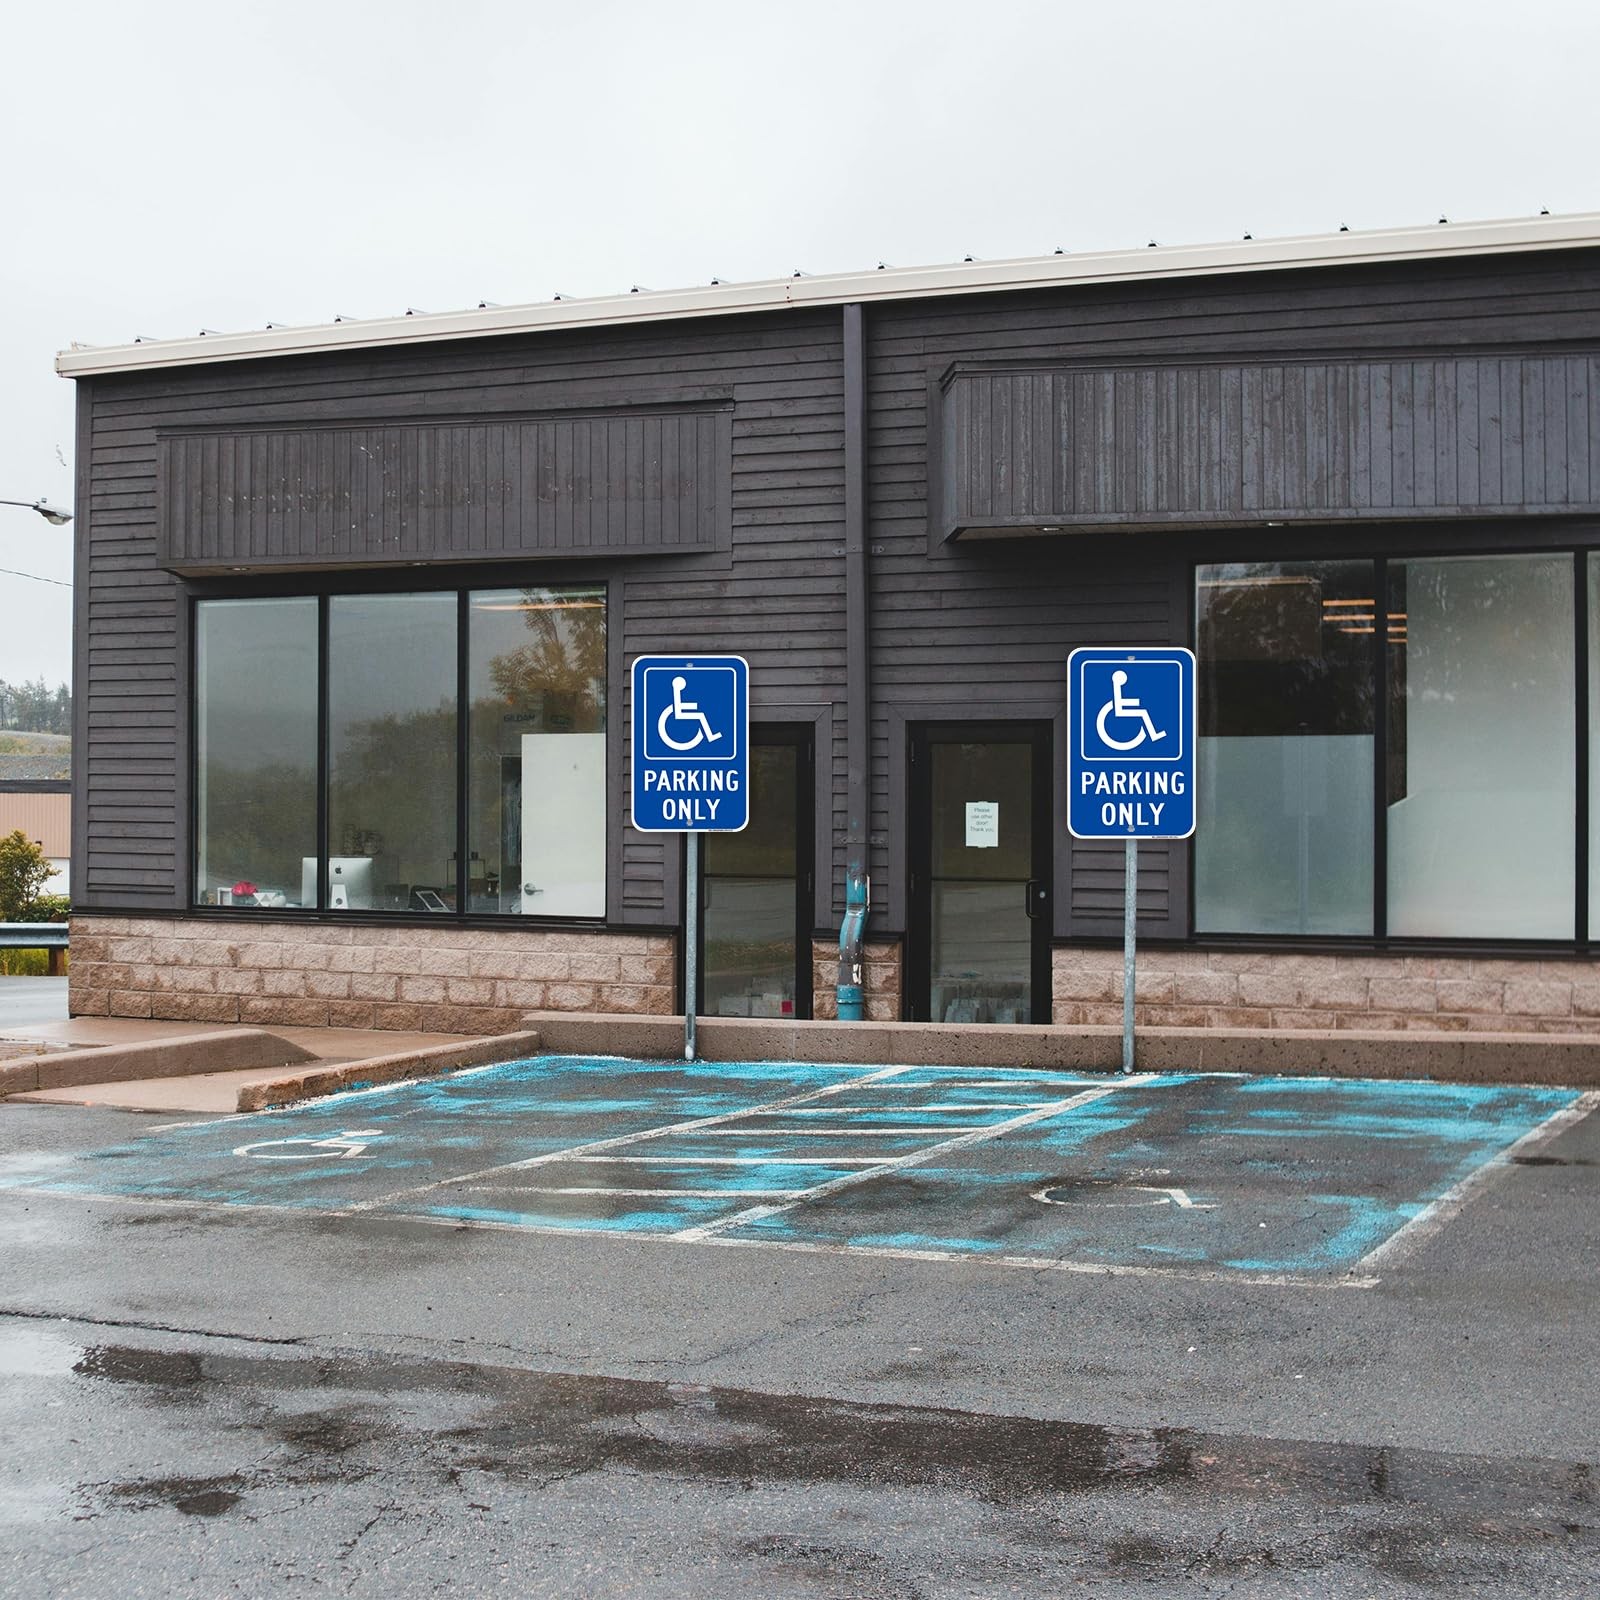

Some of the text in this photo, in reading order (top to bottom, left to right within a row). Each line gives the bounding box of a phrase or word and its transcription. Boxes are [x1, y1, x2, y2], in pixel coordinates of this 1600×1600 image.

[644, 770, 739, 792] PARKING
[1081, 772, 1185, 795] PARKING
[662, 799, 721, 820] ONLY
[1101, 803, 1165, 826] ONLY
